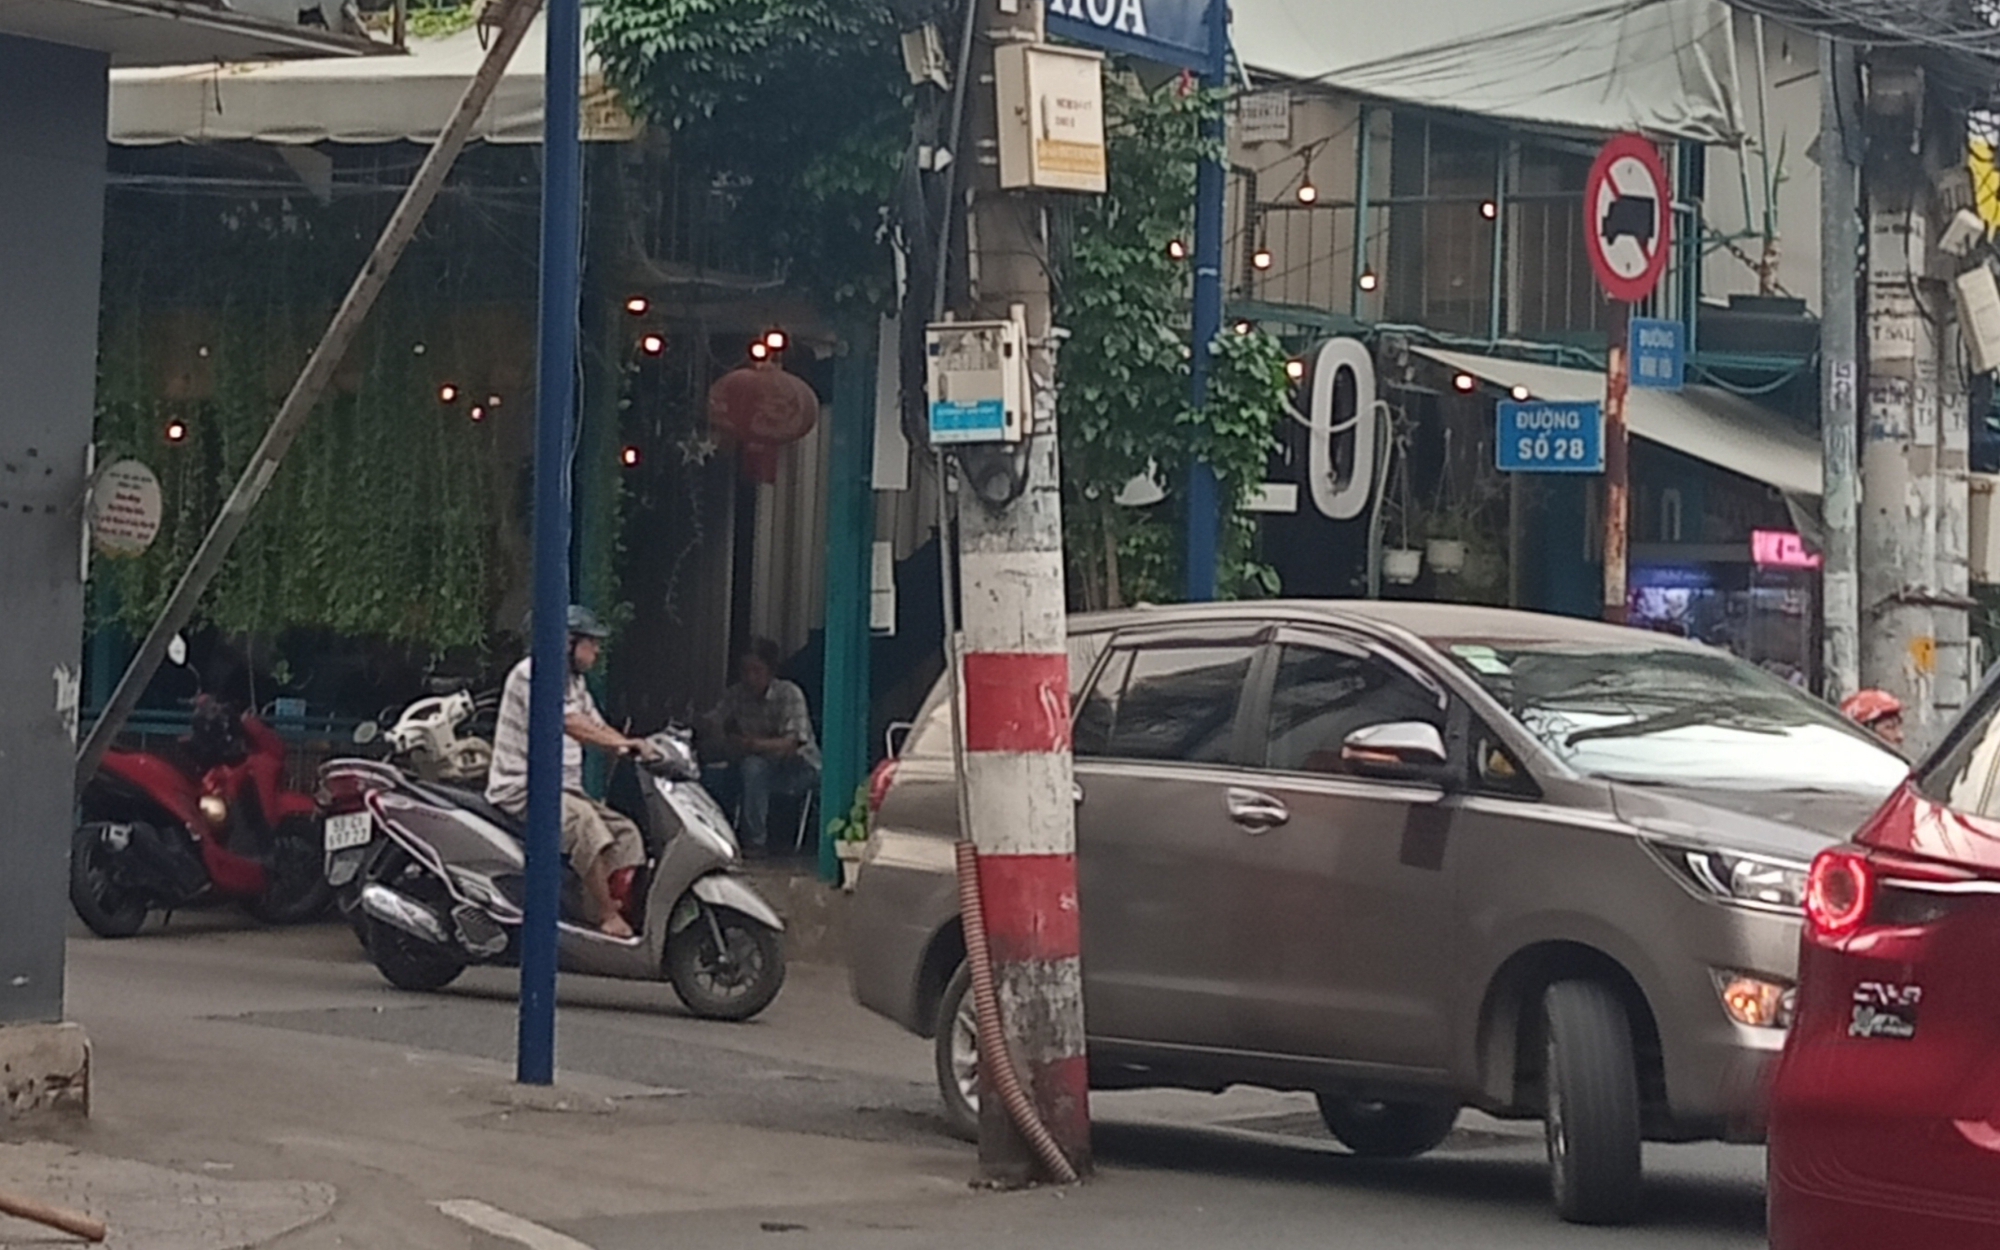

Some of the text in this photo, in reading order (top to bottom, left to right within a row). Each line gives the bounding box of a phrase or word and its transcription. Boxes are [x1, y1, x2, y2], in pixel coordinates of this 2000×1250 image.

[1515, 406, 1580, 429] ĐƯỜNG
[1518, 429, 1584, 460] SỐ 28
